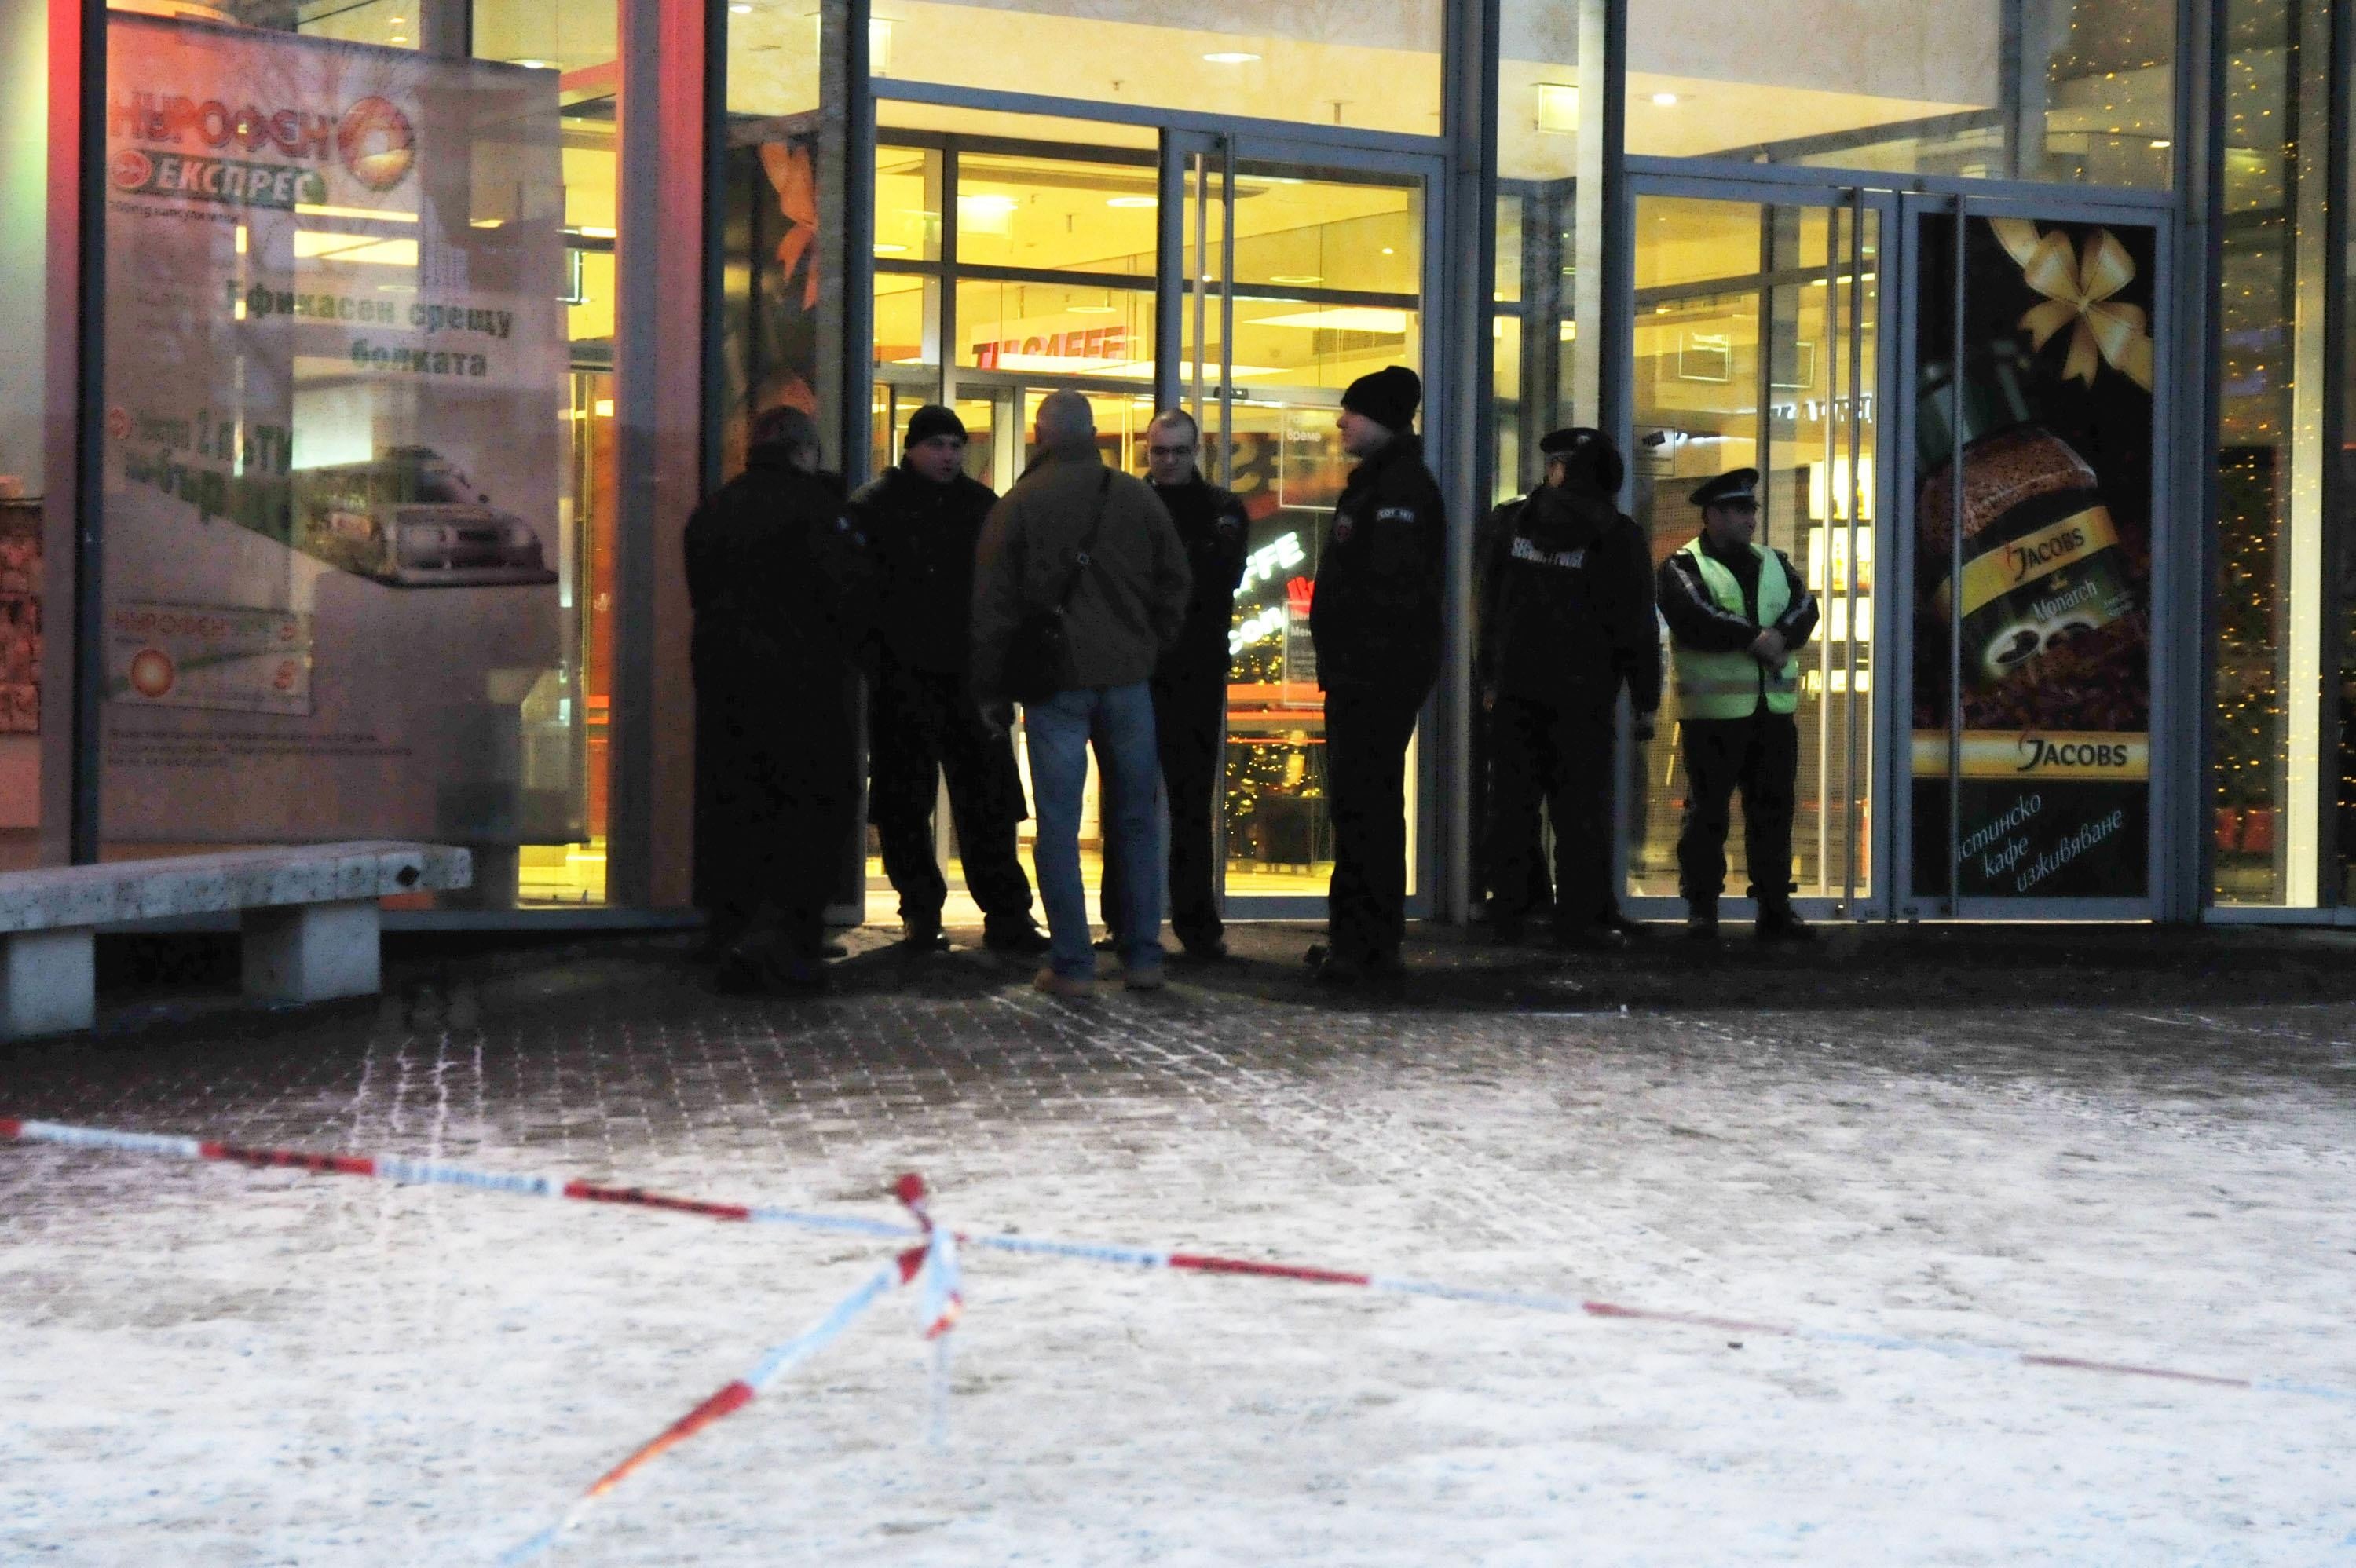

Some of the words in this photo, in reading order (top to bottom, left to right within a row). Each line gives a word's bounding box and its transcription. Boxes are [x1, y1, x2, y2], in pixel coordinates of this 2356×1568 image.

[2008, 528, 2085, 583] JACOBS
[2032, 579, 2098, 622] Monarch
[2017, 739, 2127, 771] JACOBS
[1984, 836, 2029, 879] кафе
[2016, 809, 2123, 893] изживяване
